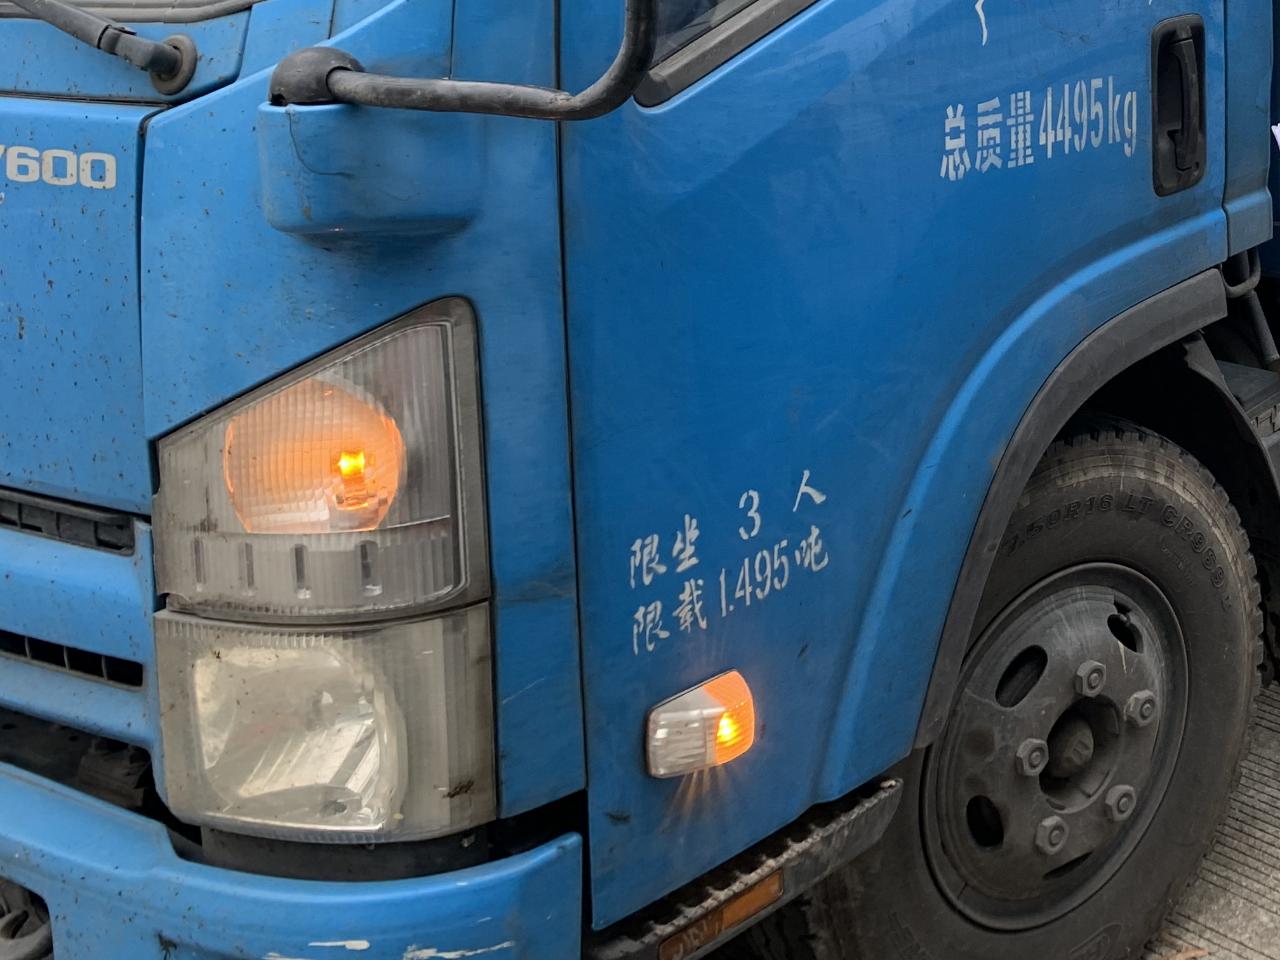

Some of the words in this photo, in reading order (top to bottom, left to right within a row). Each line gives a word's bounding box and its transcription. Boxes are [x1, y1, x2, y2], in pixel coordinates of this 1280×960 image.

[940, 75, 1137, 181] 总质量4495kg
[738, 489, 762, 540] 3
[792, 469, 826, 512] 人
